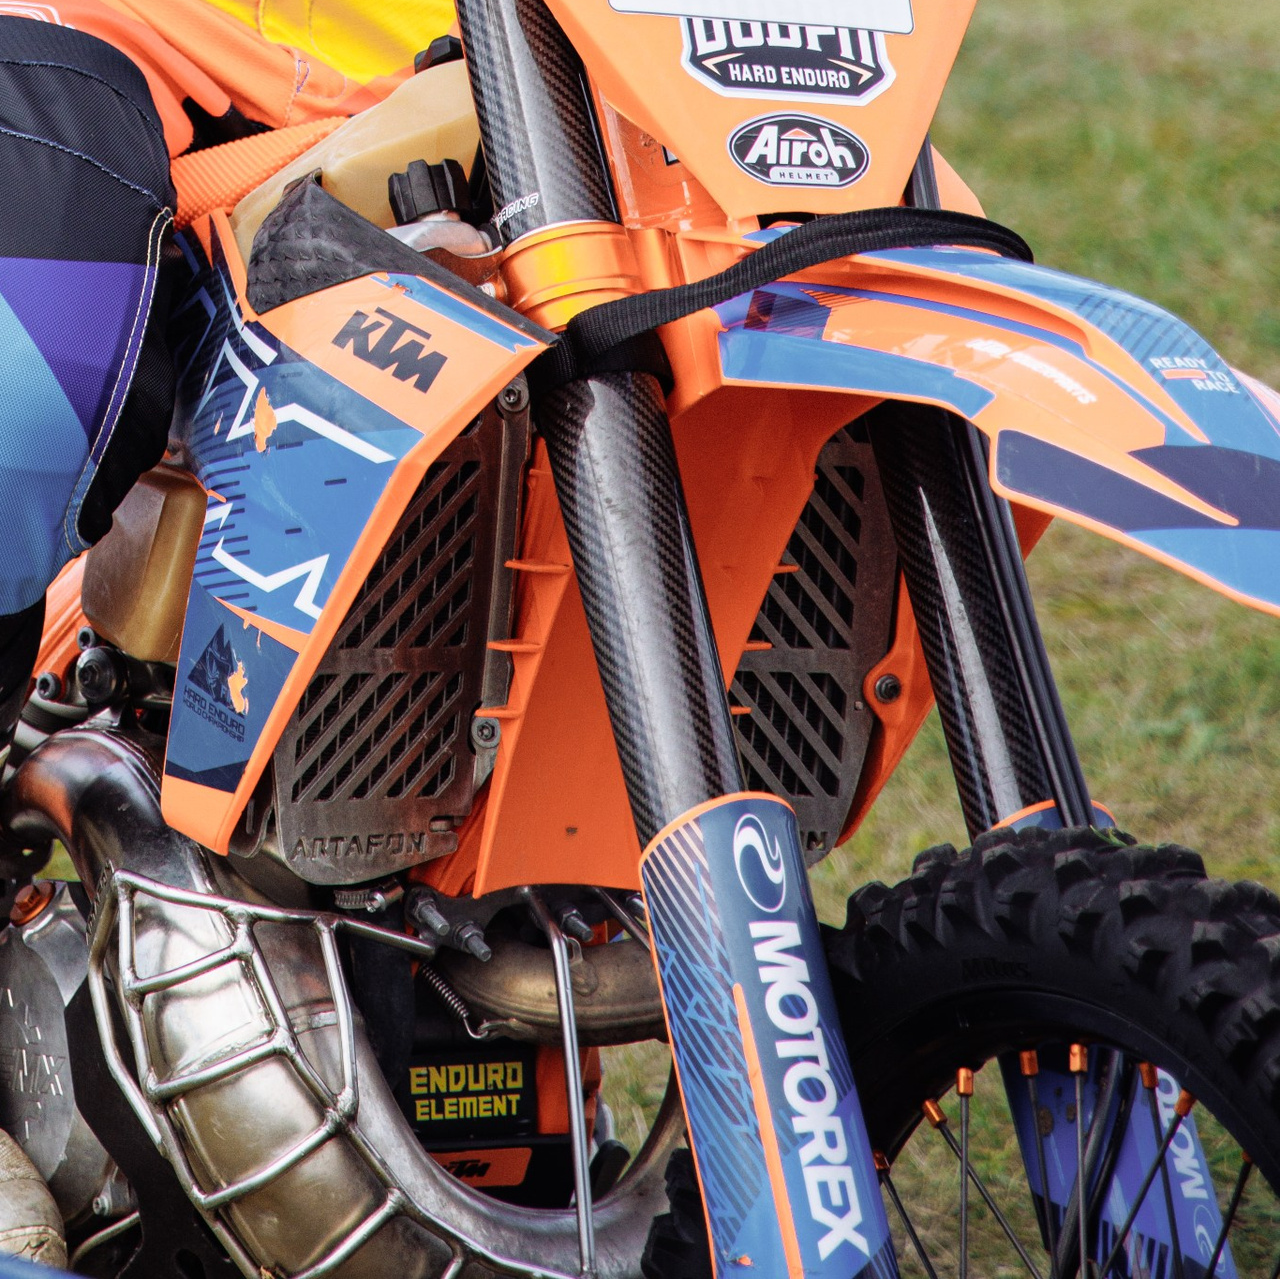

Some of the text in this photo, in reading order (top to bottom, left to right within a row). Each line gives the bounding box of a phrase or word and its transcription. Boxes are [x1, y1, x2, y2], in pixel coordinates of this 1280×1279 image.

[729, 62, 851, 89] HARD ENDURO
[743, 124, 857, 169] Airoh
[779, 171, 830, 181] HELMET
[331, 307, 448, 394] KTM
[1150, 356, 1207, 370] READY
[1193, 379, 1241, 394] RACE
[1210, 371, 1229, 382] TO
[183, 685, 206, 710] HARD
[208, 703, 245, 736] ENDURO
[409, 1061, 523, 1094] ENDURO
[748, 919, 871, 1260] MOTOREX
[415, 1094, 521, 1121] ELEMENT
